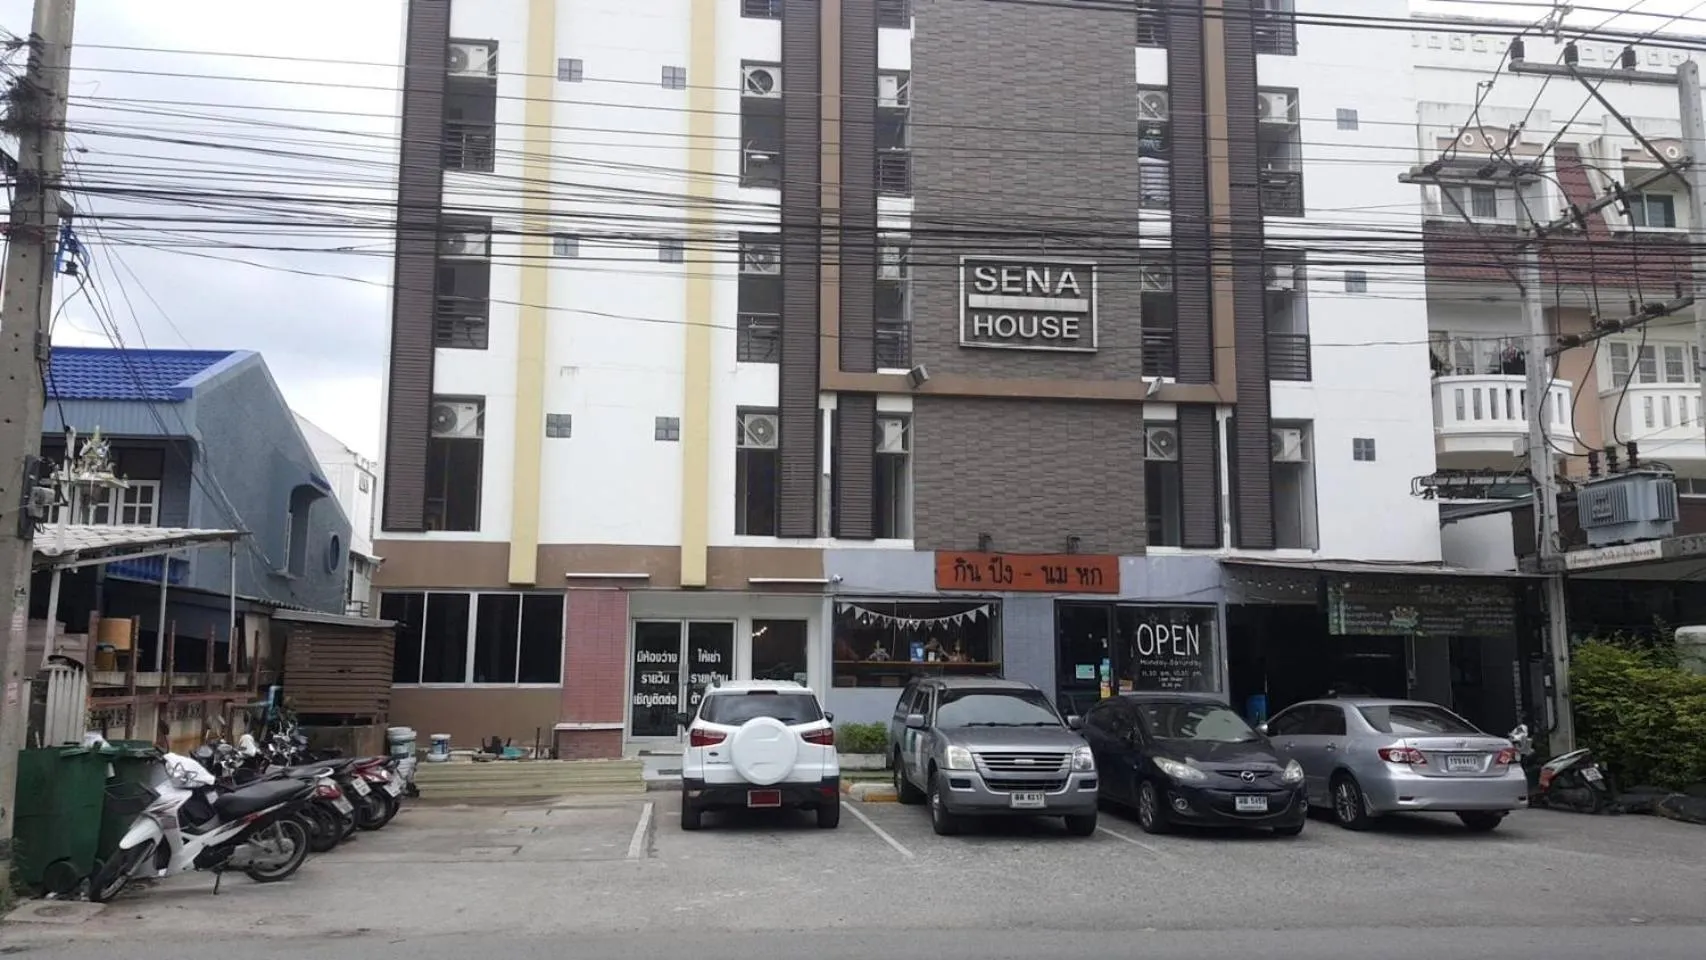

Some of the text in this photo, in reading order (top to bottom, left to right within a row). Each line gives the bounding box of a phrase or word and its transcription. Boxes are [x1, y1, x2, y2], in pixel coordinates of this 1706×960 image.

[974, 266, 1081, 295] SENA
[973, 314, 1081, 339] HOUSE
[954, 557, 981, 582] กิน
[1041, 565, 1068, 585] นม
[1076, 566, 1103, 586] หก
[1137, 623, 1199, 656] OPEN
[641, 671, 670, 684] รายวัน
[633, 692, 677, 708] เชิญติดต่อ
